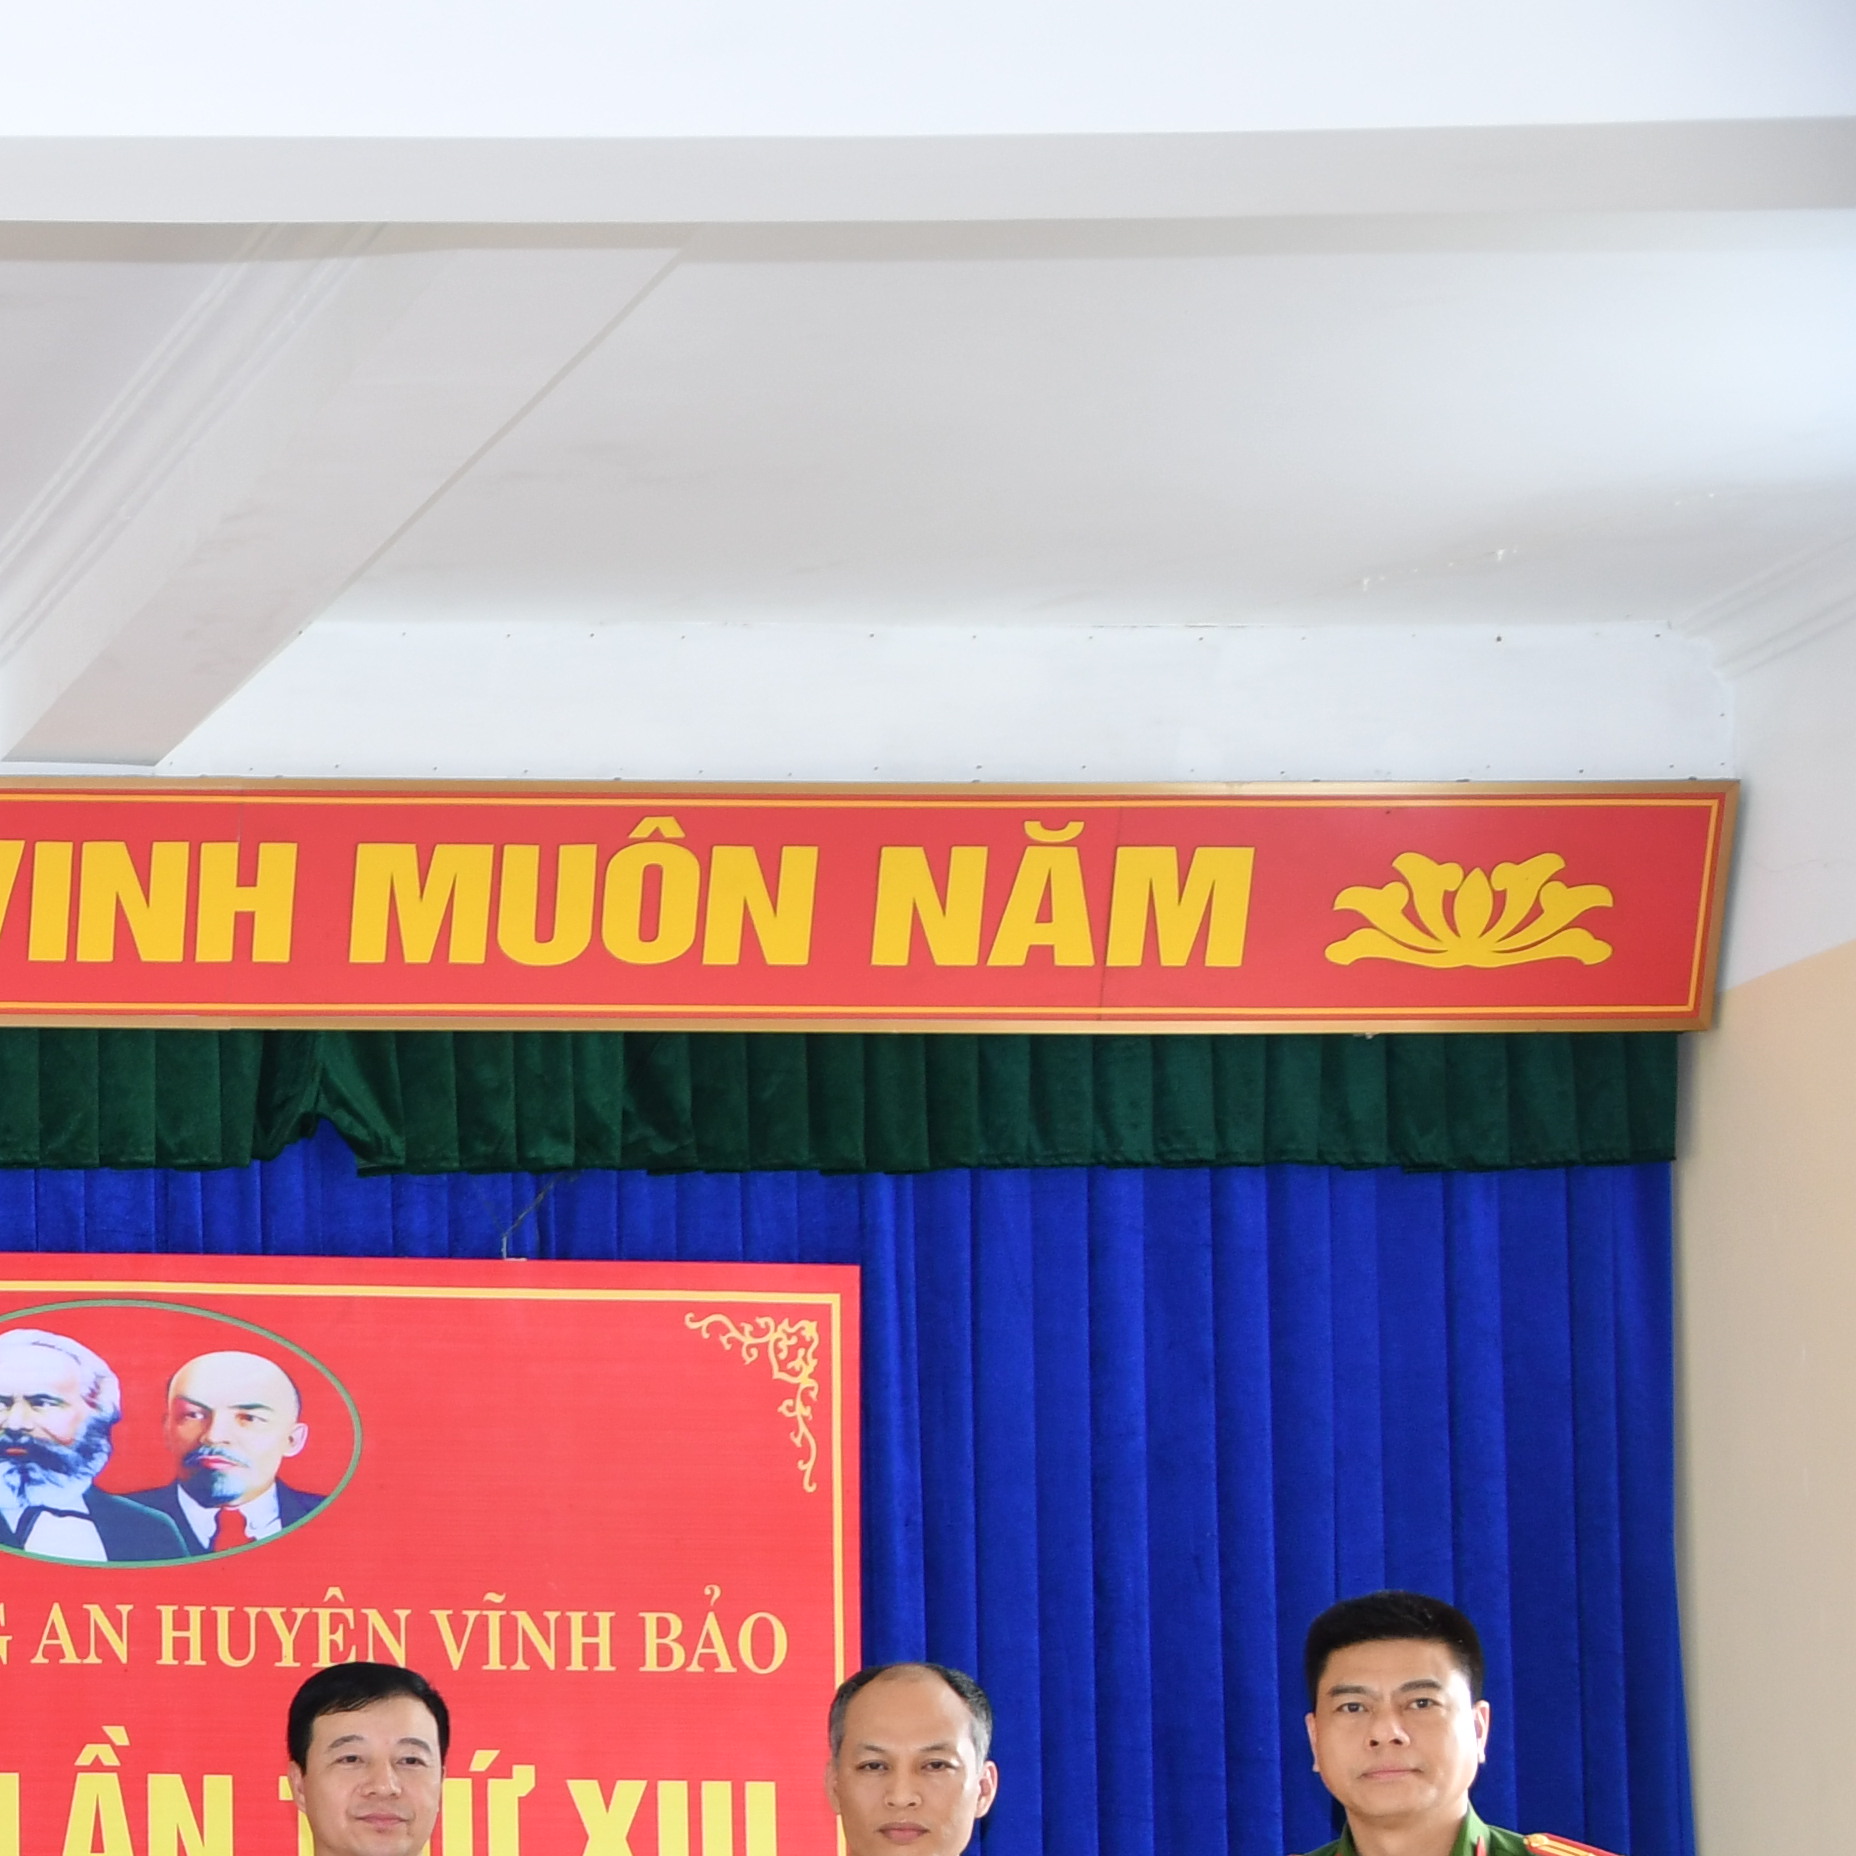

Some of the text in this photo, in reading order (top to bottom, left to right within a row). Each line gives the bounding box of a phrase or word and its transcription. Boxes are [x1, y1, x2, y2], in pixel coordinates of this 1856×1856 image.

[348, 815, 819, 967] MUÔN
[870, 820, 1256, 967] NĂM
[29, 1602, 135, 1665] AN
[428, 1591, 618, 1672] VĨNH
[637, 1584, 789, 1675] BẢO
